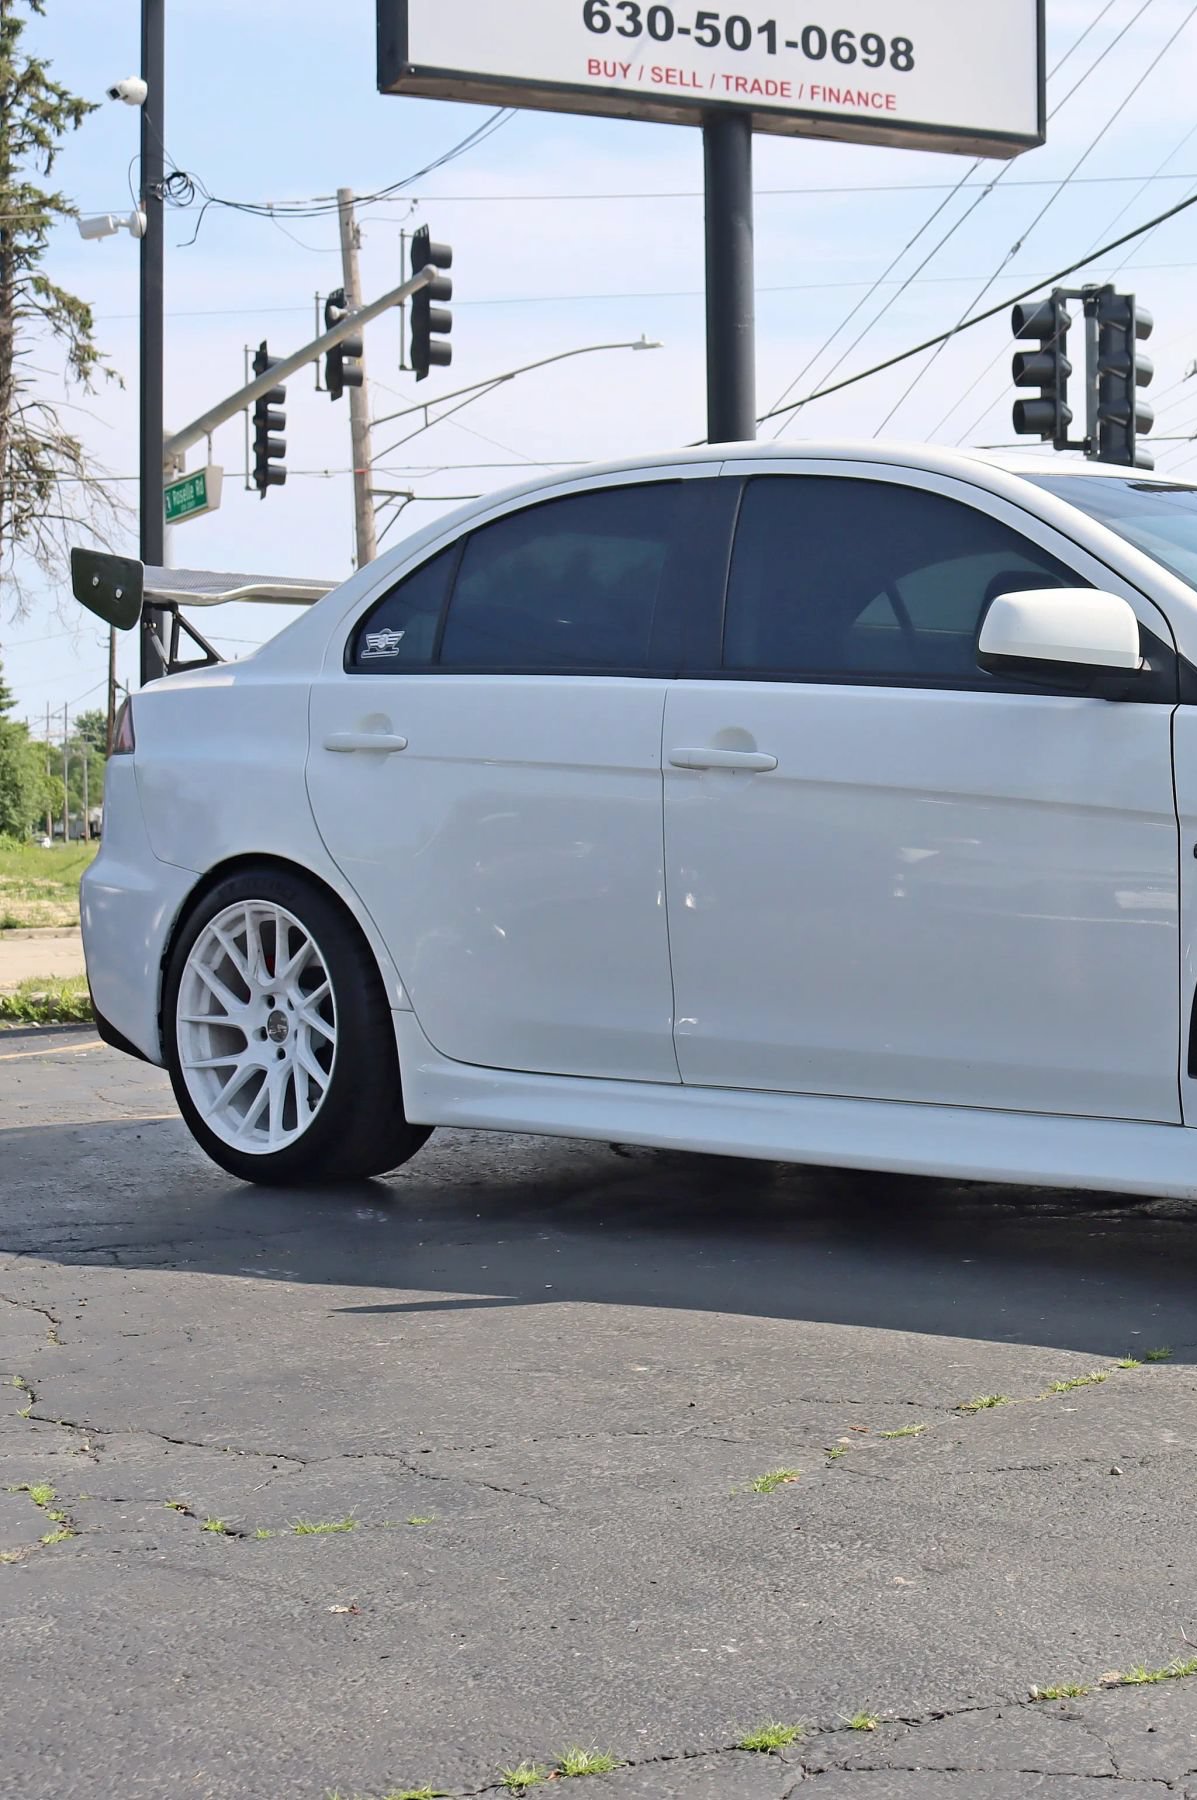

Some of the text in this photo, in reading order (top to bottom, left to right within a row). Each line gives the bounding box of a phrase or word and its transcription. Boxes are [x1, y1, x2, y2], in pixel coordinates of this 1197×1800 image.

[583, 0, 915, 72] 630-501-0698
[587, 58, 897, 110] BUY / SELL / TRADE / FINANCE
[195, 476, 204, 496] Rd
